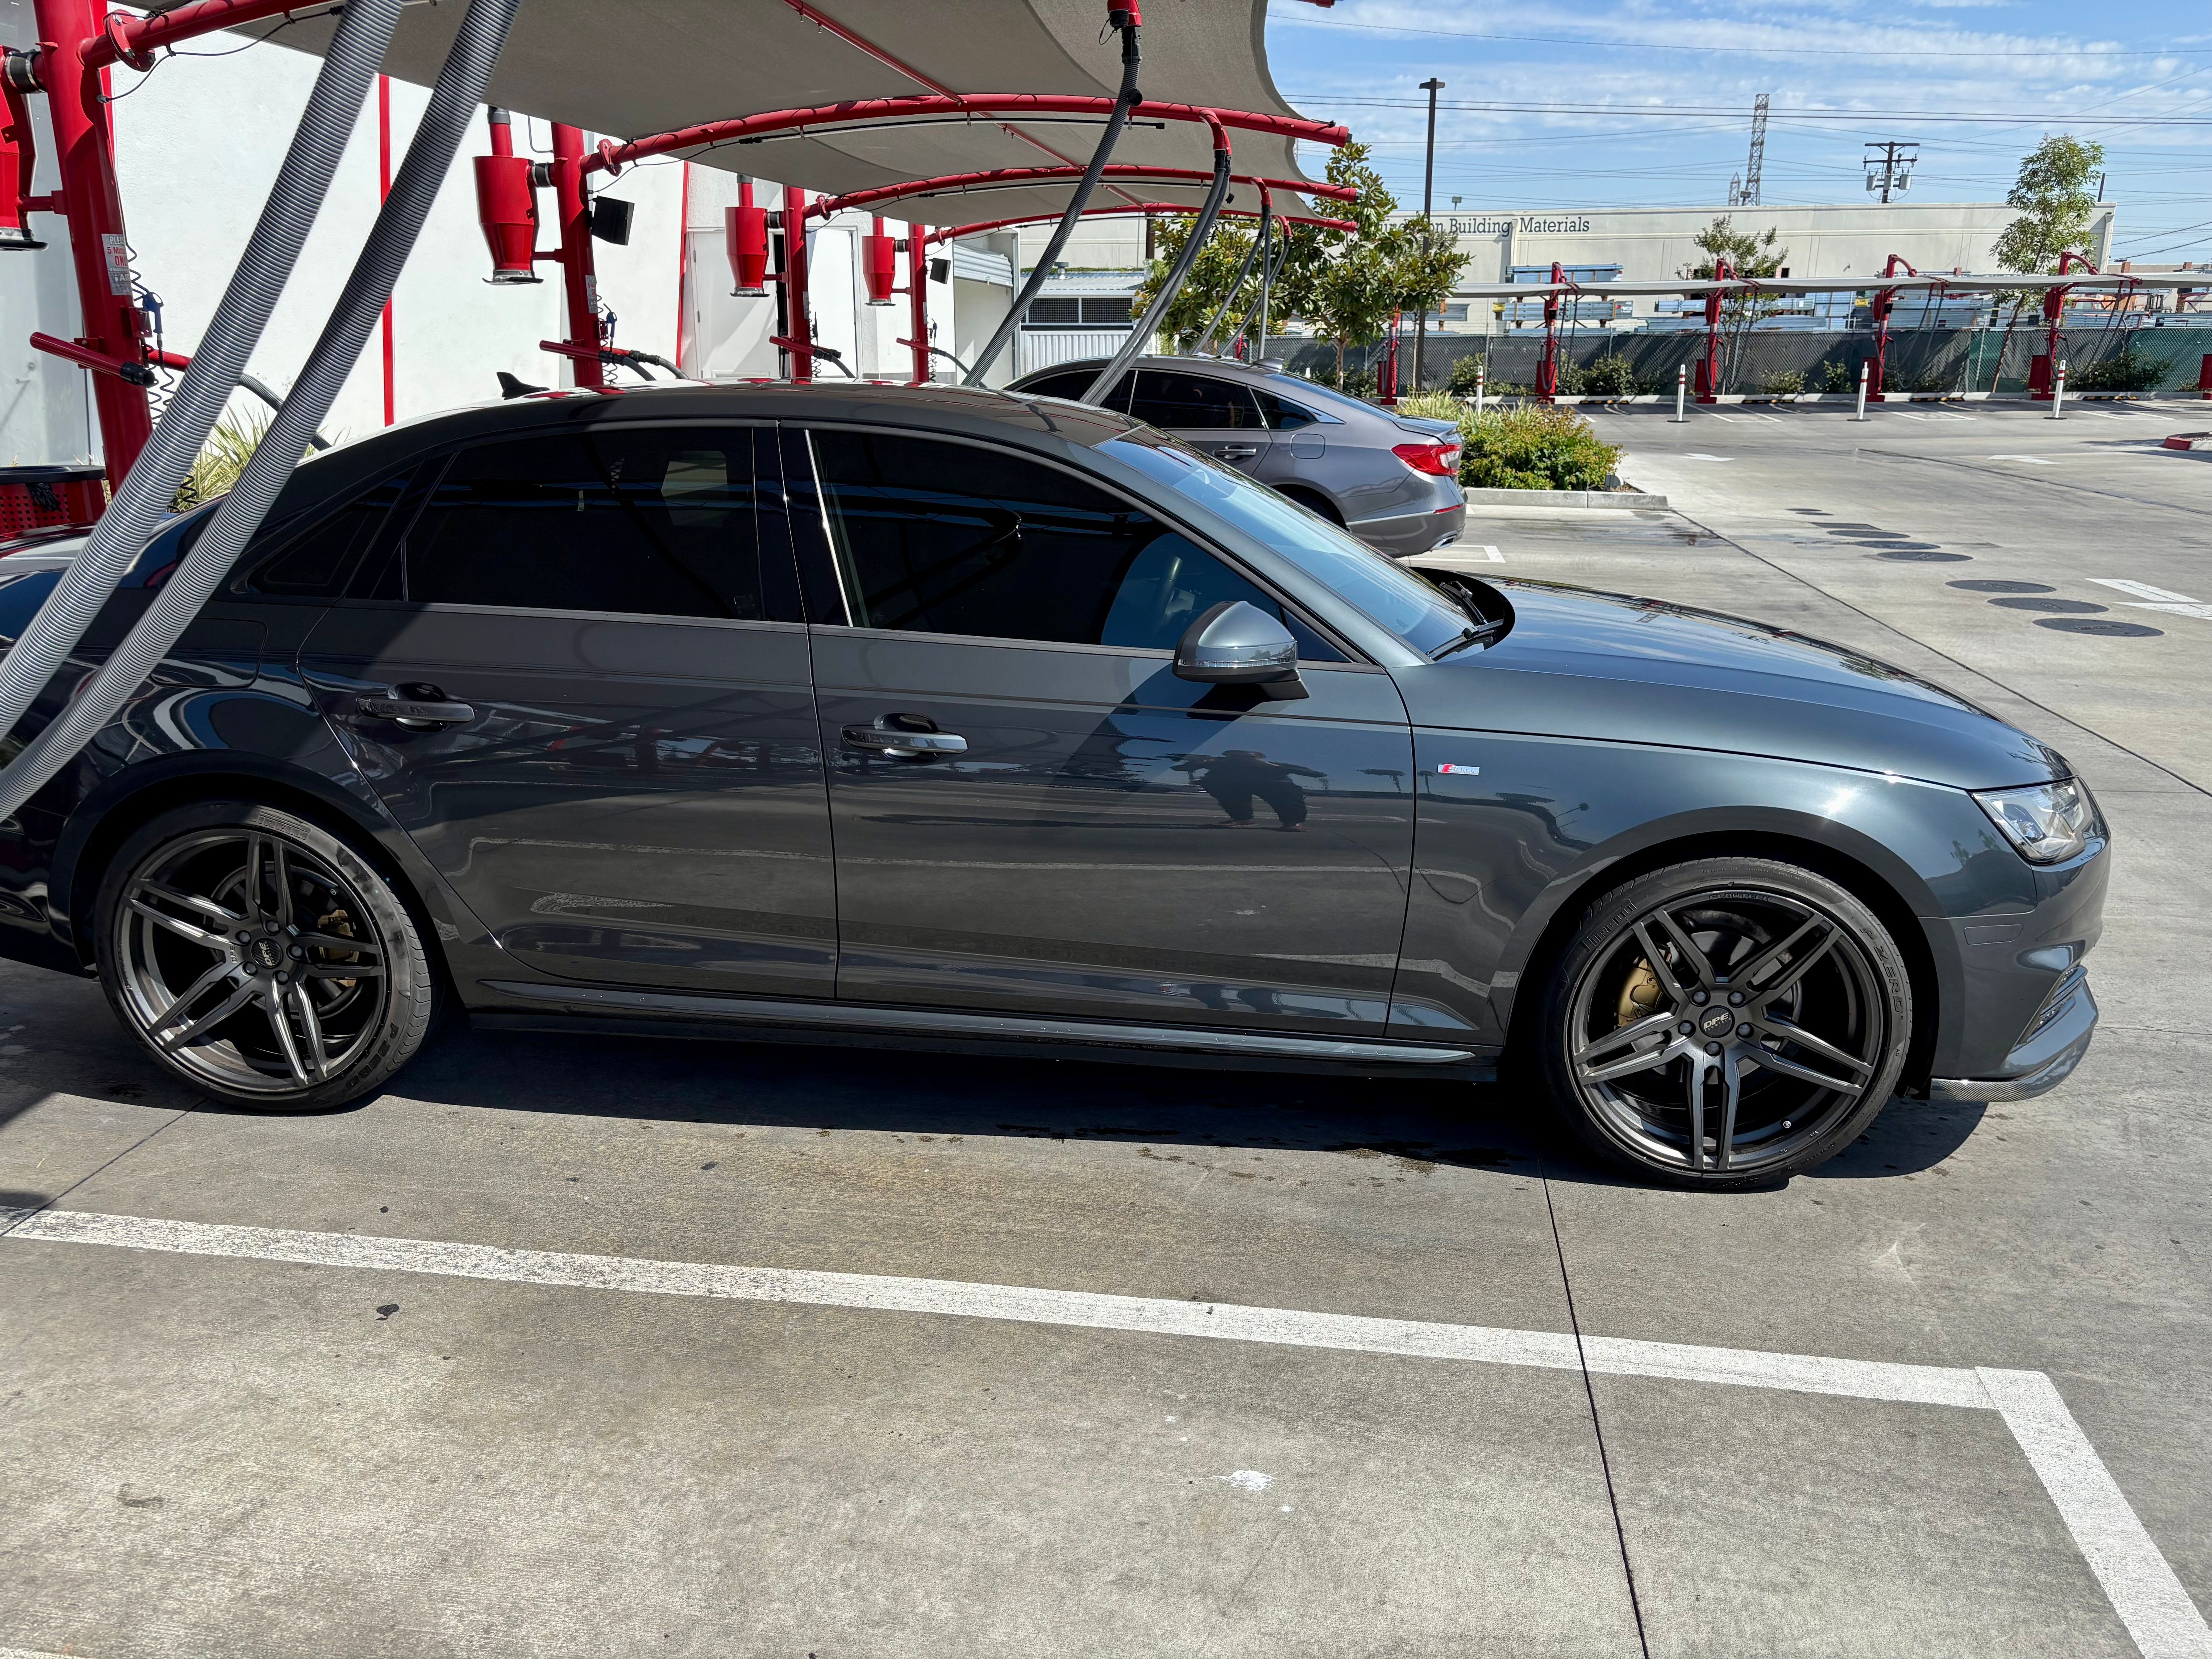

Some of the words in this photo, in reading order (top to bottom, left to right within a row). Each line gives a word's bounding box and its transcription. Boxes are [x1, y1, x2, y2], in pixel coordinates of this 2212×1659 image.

[1449, 218, 1511, 237] Building
[1519, 216, 1589, 233] Materials
[259, 942, 273, 966] DPE
[1704, 1012, 1729, 1029] DPE
